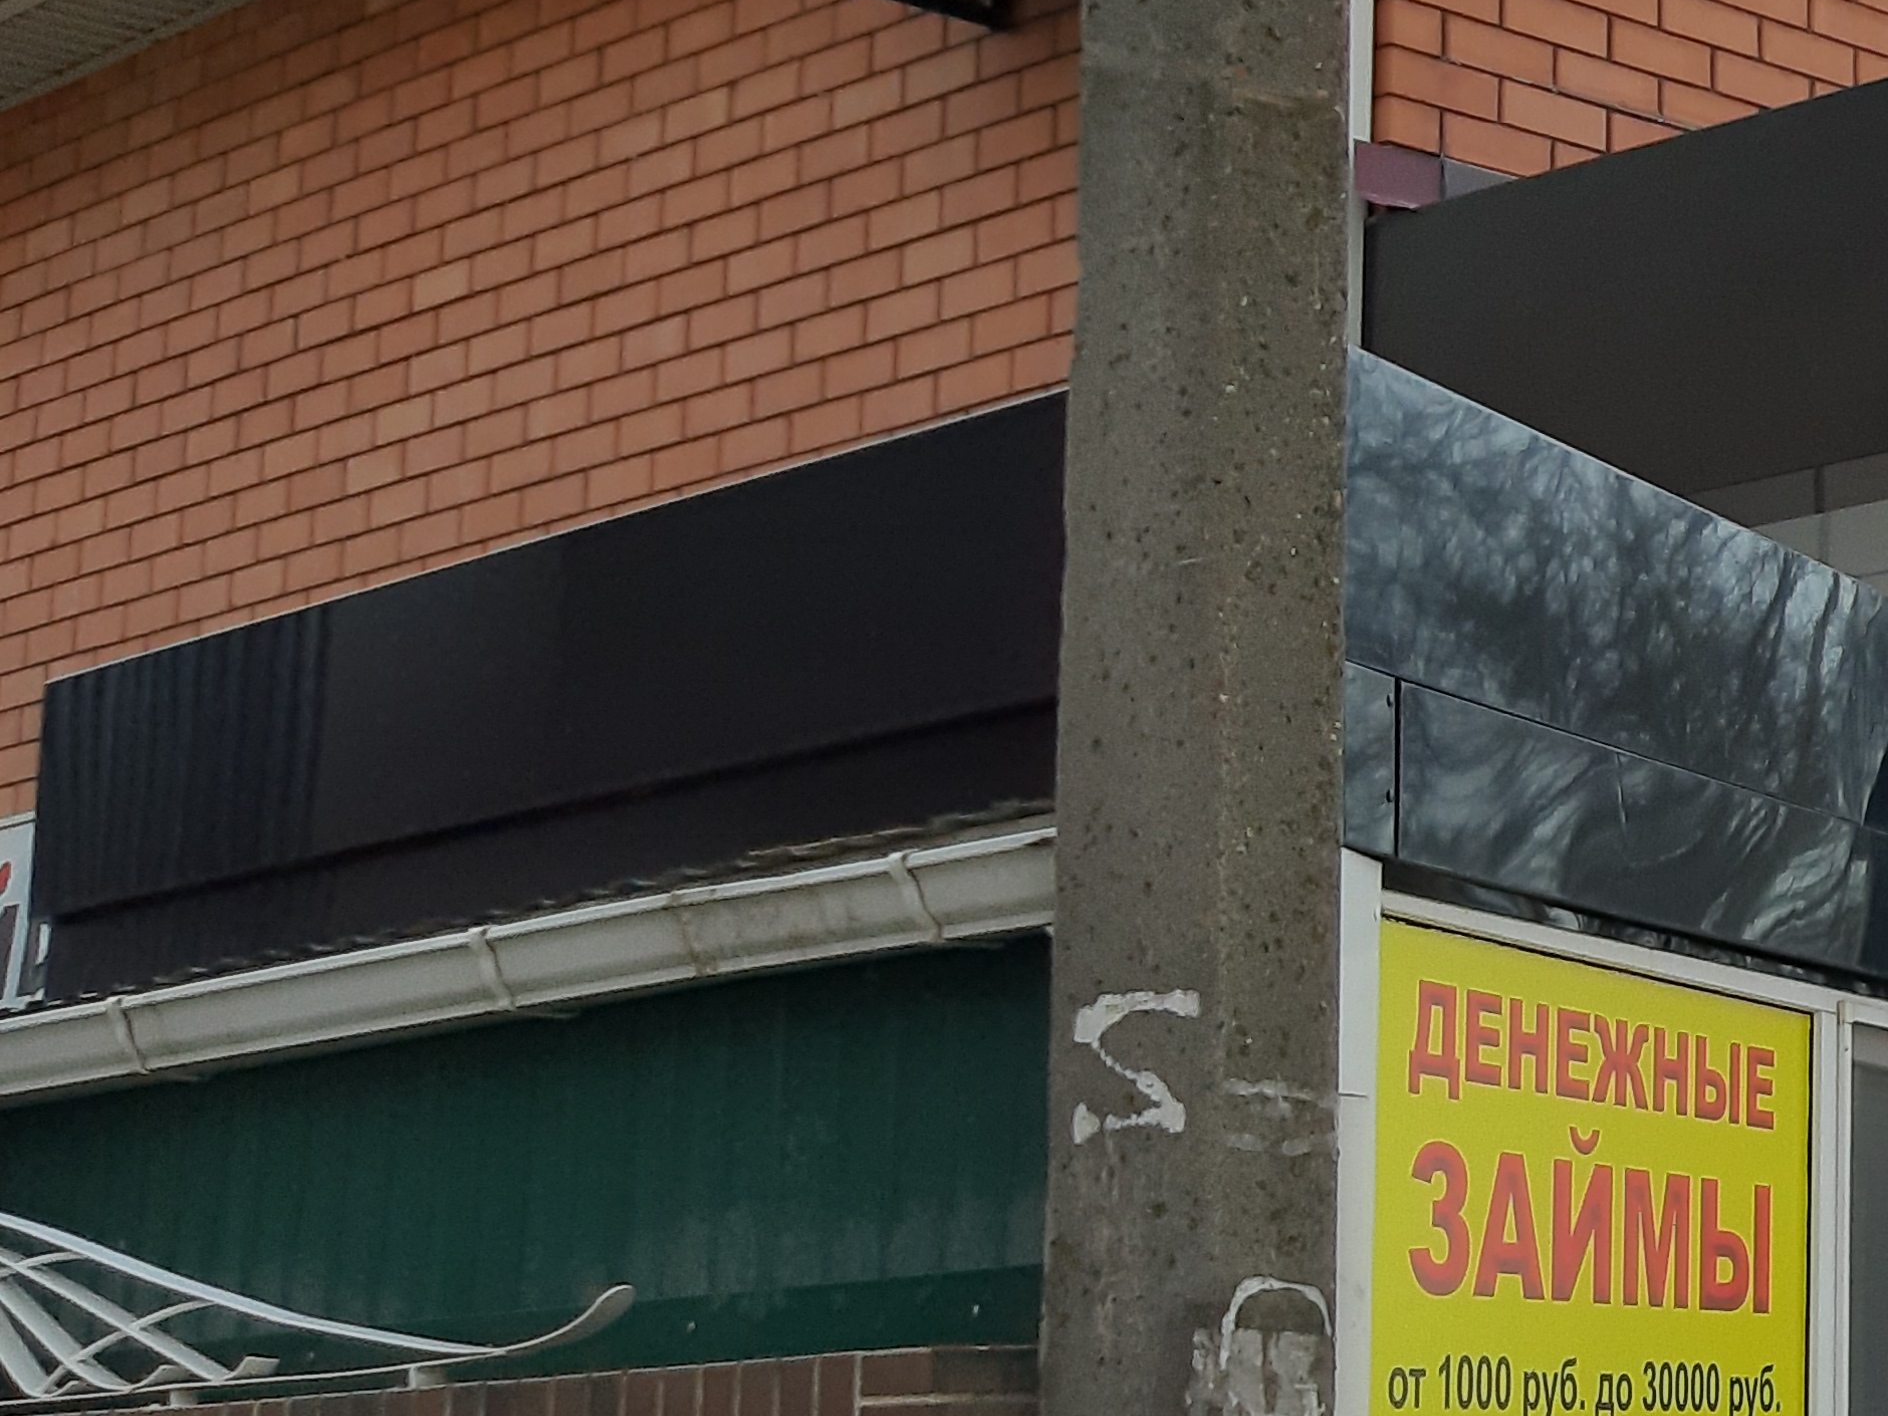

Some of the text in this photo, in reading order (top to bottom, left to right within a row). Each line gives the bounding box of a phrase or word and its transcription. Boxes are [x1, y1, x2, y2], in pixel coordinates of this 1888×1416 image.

[1408, 979, 1775, 1130] ДЕНЕЖНЫЕ
[1408, 1126, 1771, 1314] ЗАЙМЫ
[1388, 1367, 1427, 1410] от
[1438, 1354, 1511, 1410] 1000
[1642, 1361, 1720, 1412] 30000
